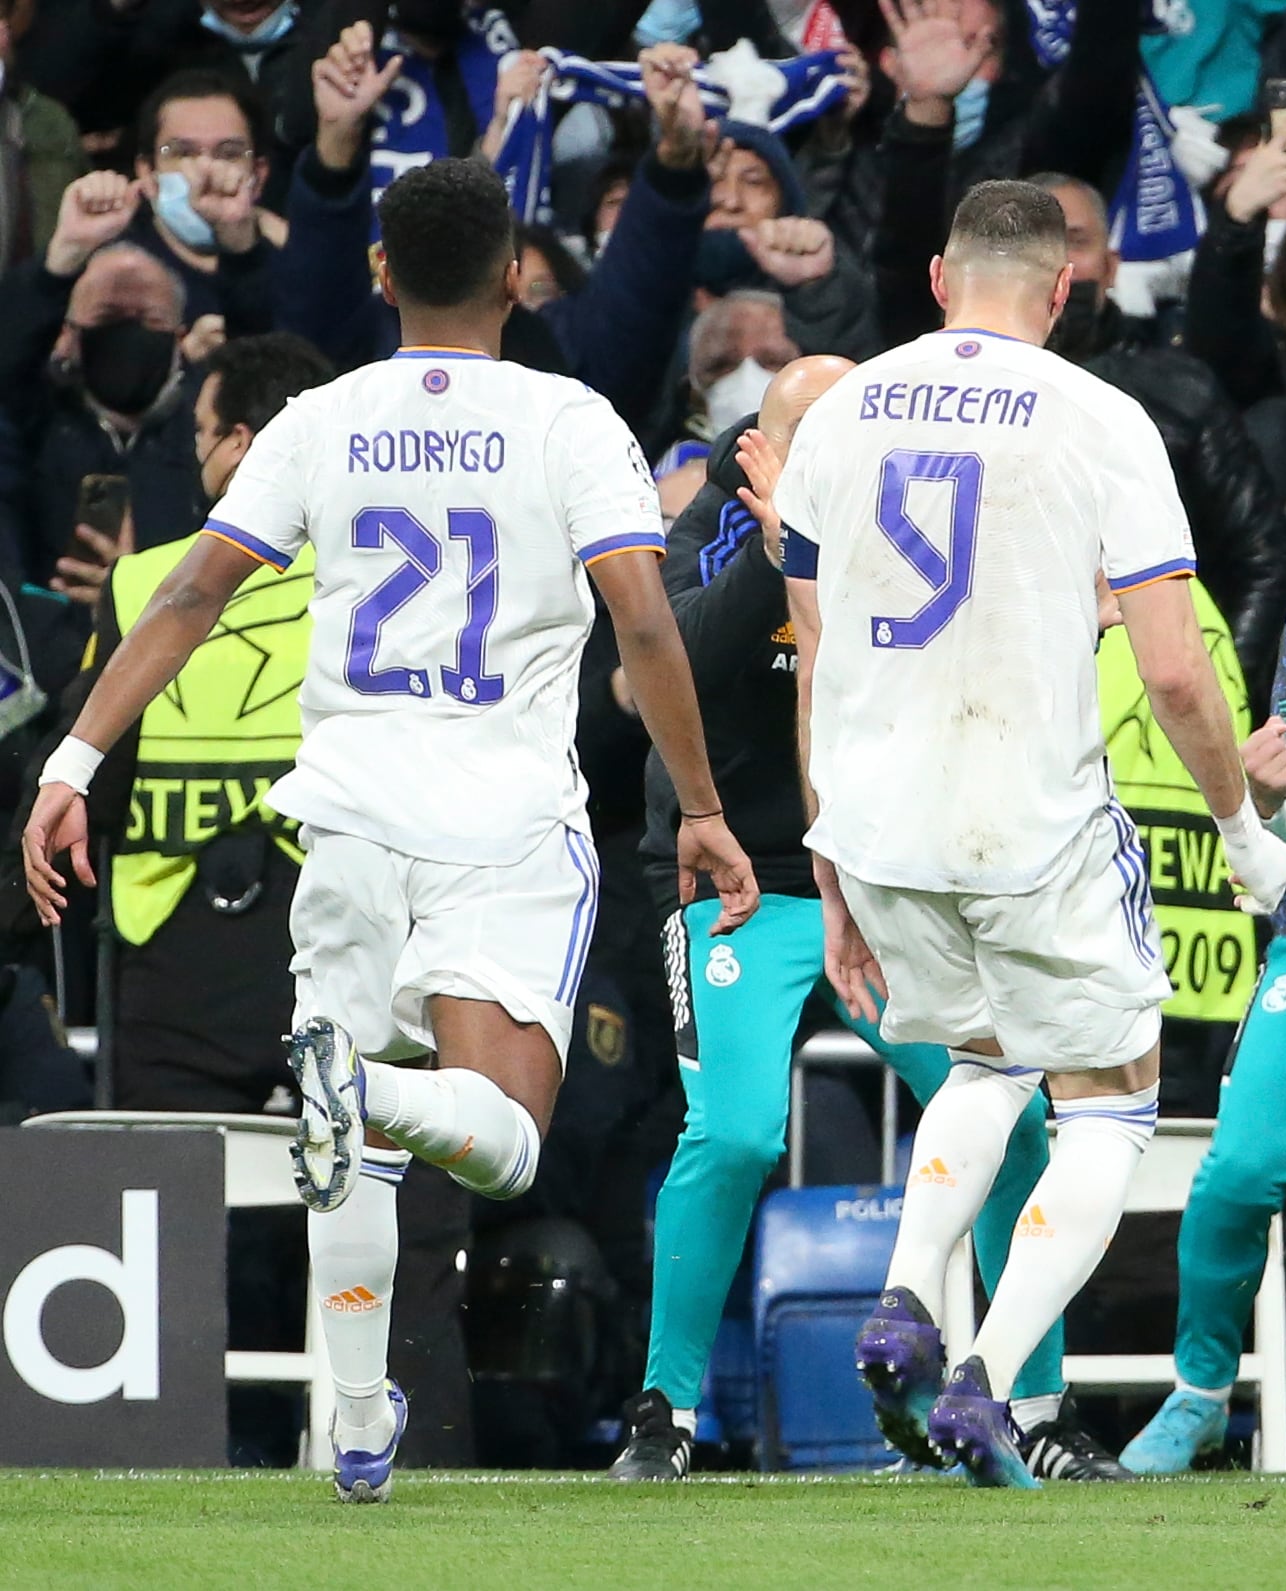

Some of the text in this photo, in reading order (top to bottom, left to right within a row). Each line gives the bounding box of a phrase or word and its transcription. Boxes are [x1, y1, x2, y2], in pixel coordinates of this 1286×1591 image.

[860, 383, 1038, 427] BENZEMA
[349, 430, 504, 473] RODRYGO
[871, 448, 984, 649] 9
[344, 507, 504, 705] 21
[126, 777, 299, 841] STEW
[1161, 927, 1242, 995] 209
[3, 1189, 159, 1405] d
[323, 1299, 384, 1313] adidas
